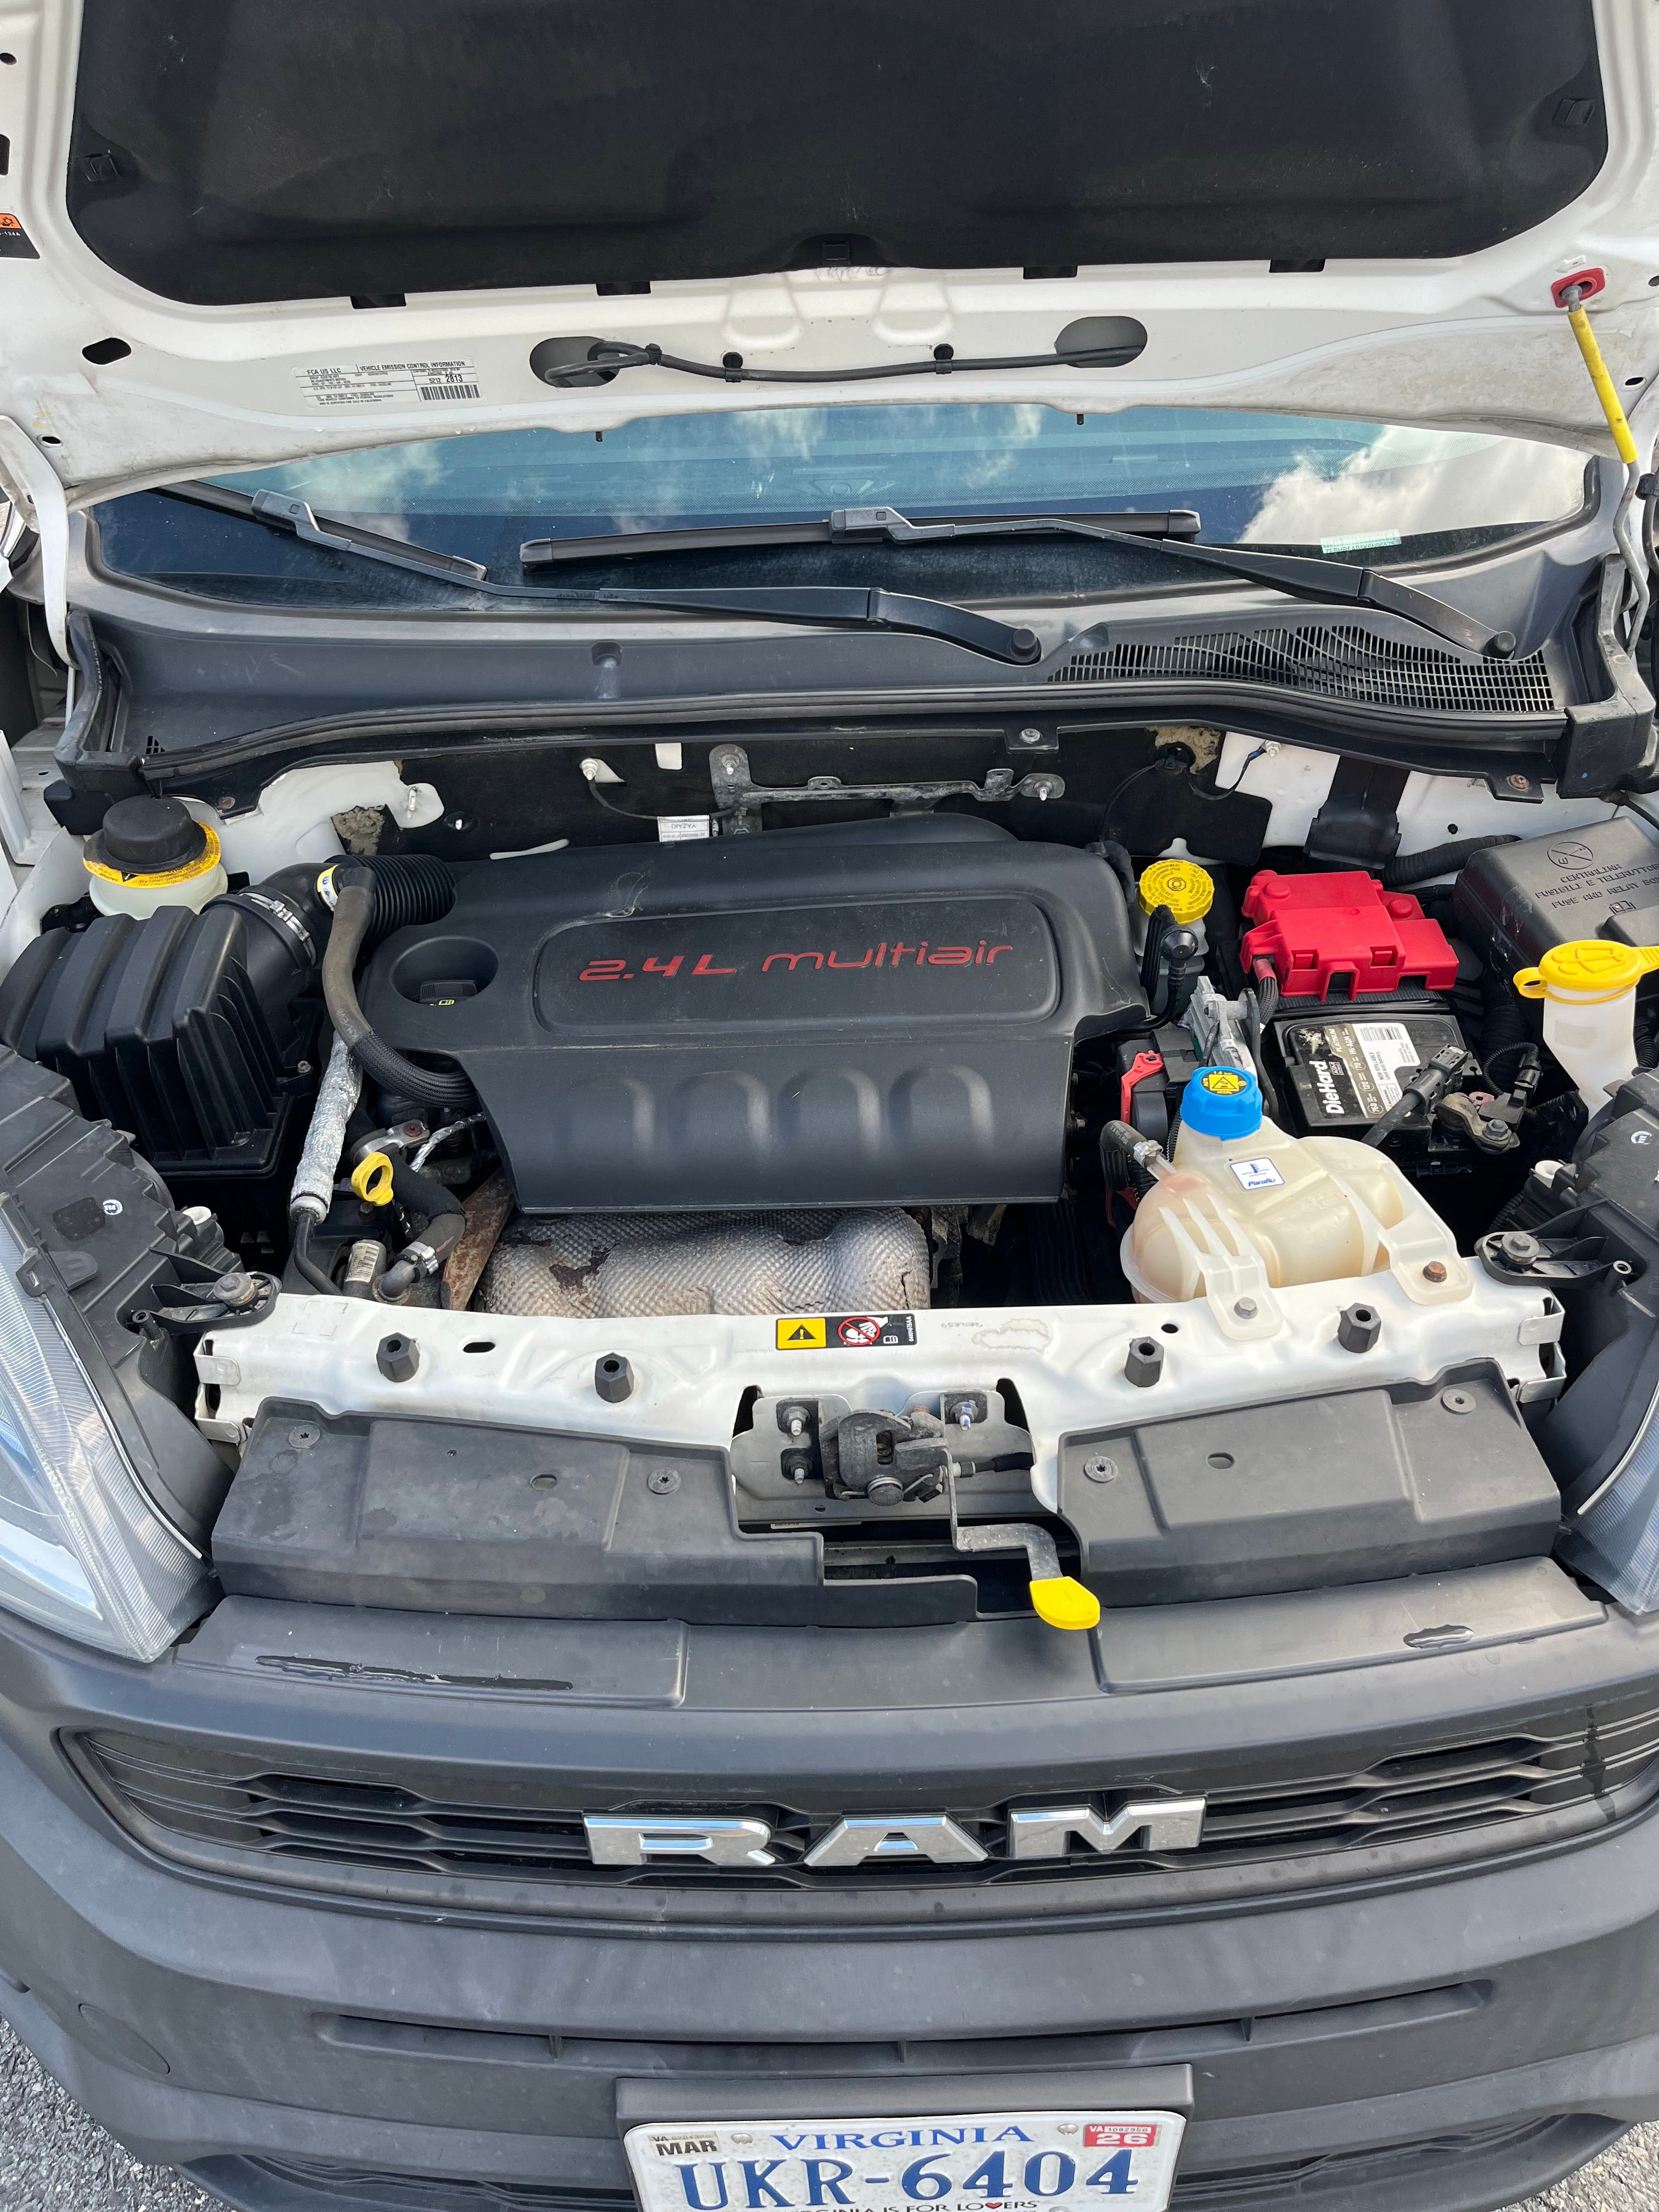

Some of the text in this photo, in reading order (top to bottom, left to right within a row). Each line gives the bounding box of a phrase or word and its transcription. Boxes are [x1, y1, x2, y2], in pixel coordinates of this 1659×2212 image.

[1560, 864, 1623, 883] CENTRALINA
[1535, 883, 1582, 899] FUSIBILI
[1551, 898, 1579, 909] FUSE
[1583, 891, 1603, 901] AND
[1606, 883, 1639, 895] RELAY
[761, 939, 1013, 973] multiair
[1329, 1029, 1343, 1052] PLATINUM
[1309, 1060, 1345, 1114] DieHard
[1370, 1103, 1380, 1113] 760
[583, 1798, 1206, 1867] RAM
[656, 2140, 718, 2156] MAR
[770, 2126, 1035, 2151] VIRGINIA
[1096, 2132, 1149, 2145] 26
[673, 2149, 1138, 2210] UKR-6404
